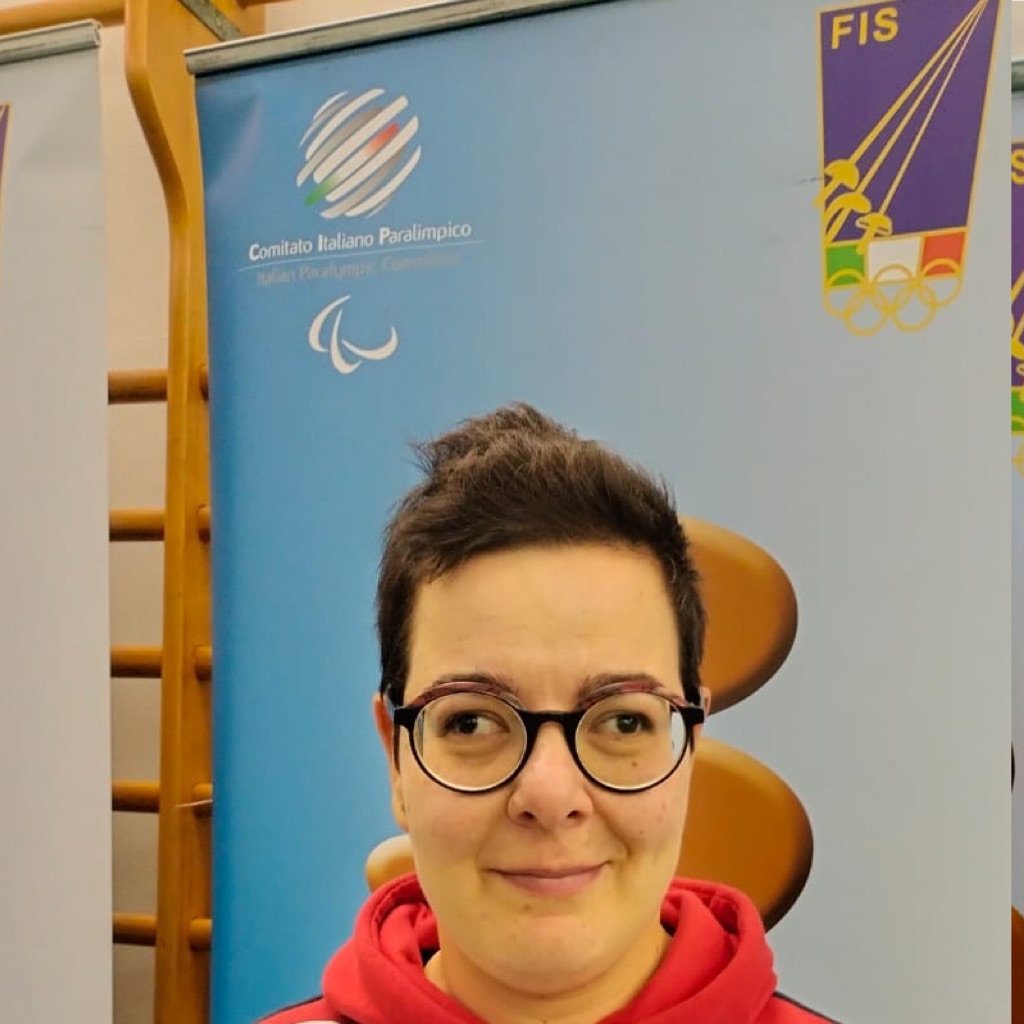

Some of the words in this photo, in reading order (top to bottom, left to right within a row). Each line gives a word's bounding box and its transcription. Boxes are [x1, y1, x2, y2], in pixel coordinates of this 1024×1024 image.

[831, 8, 898, 49] FIS
[249, 238, 313, 261] Comitato
[317, 232, 374, 251] Italiano
[378, 223, 472, 246] Paralimpico
